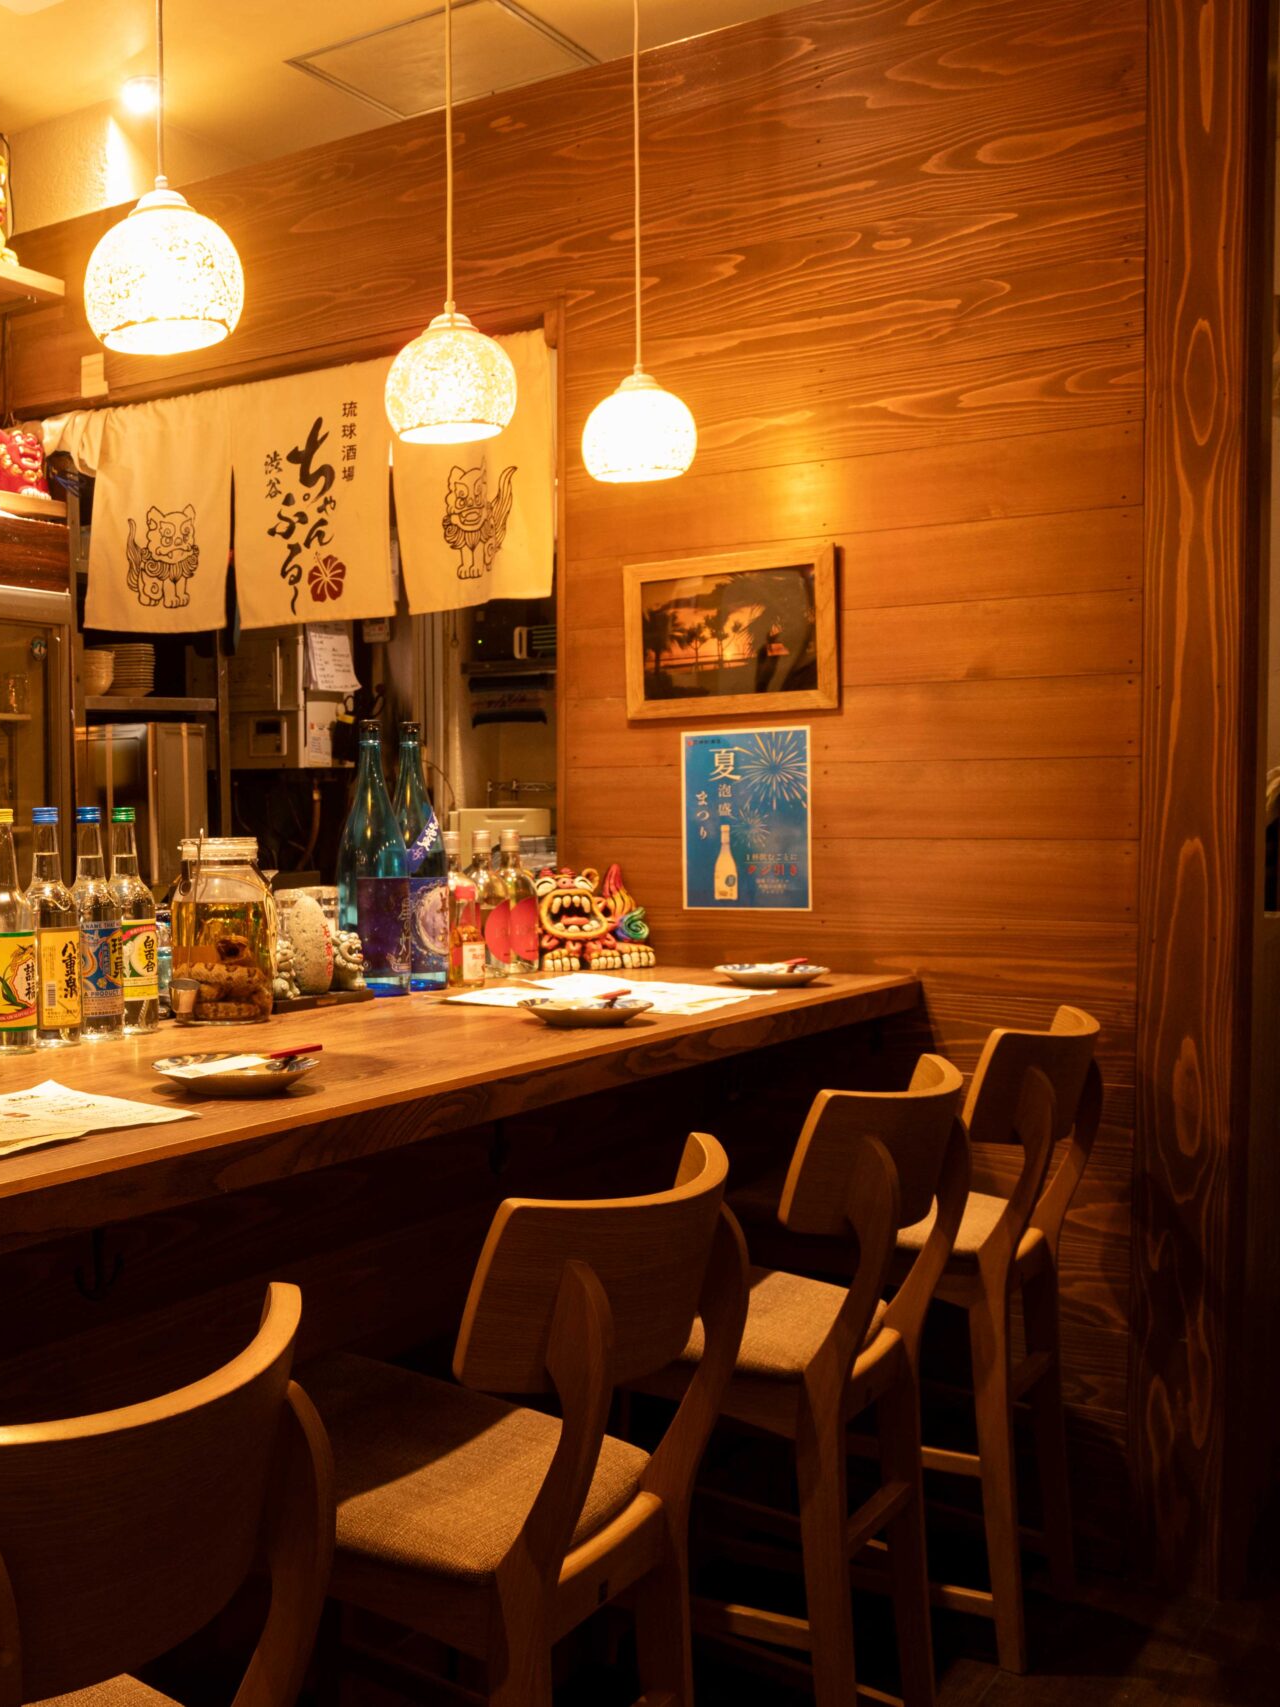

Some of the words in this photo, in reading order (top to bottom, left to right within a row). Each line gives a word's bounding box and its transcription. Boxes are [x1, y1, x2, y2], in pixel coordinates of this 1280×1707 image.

[341, 400, 358, 483] 琉球酒場
[263, 453, 283, 500] 渋谷
[696, 791, 710, 839] まつり
[61, 941, 78, 998] 八重泉
[143, 935, 156, 973] 白百合
